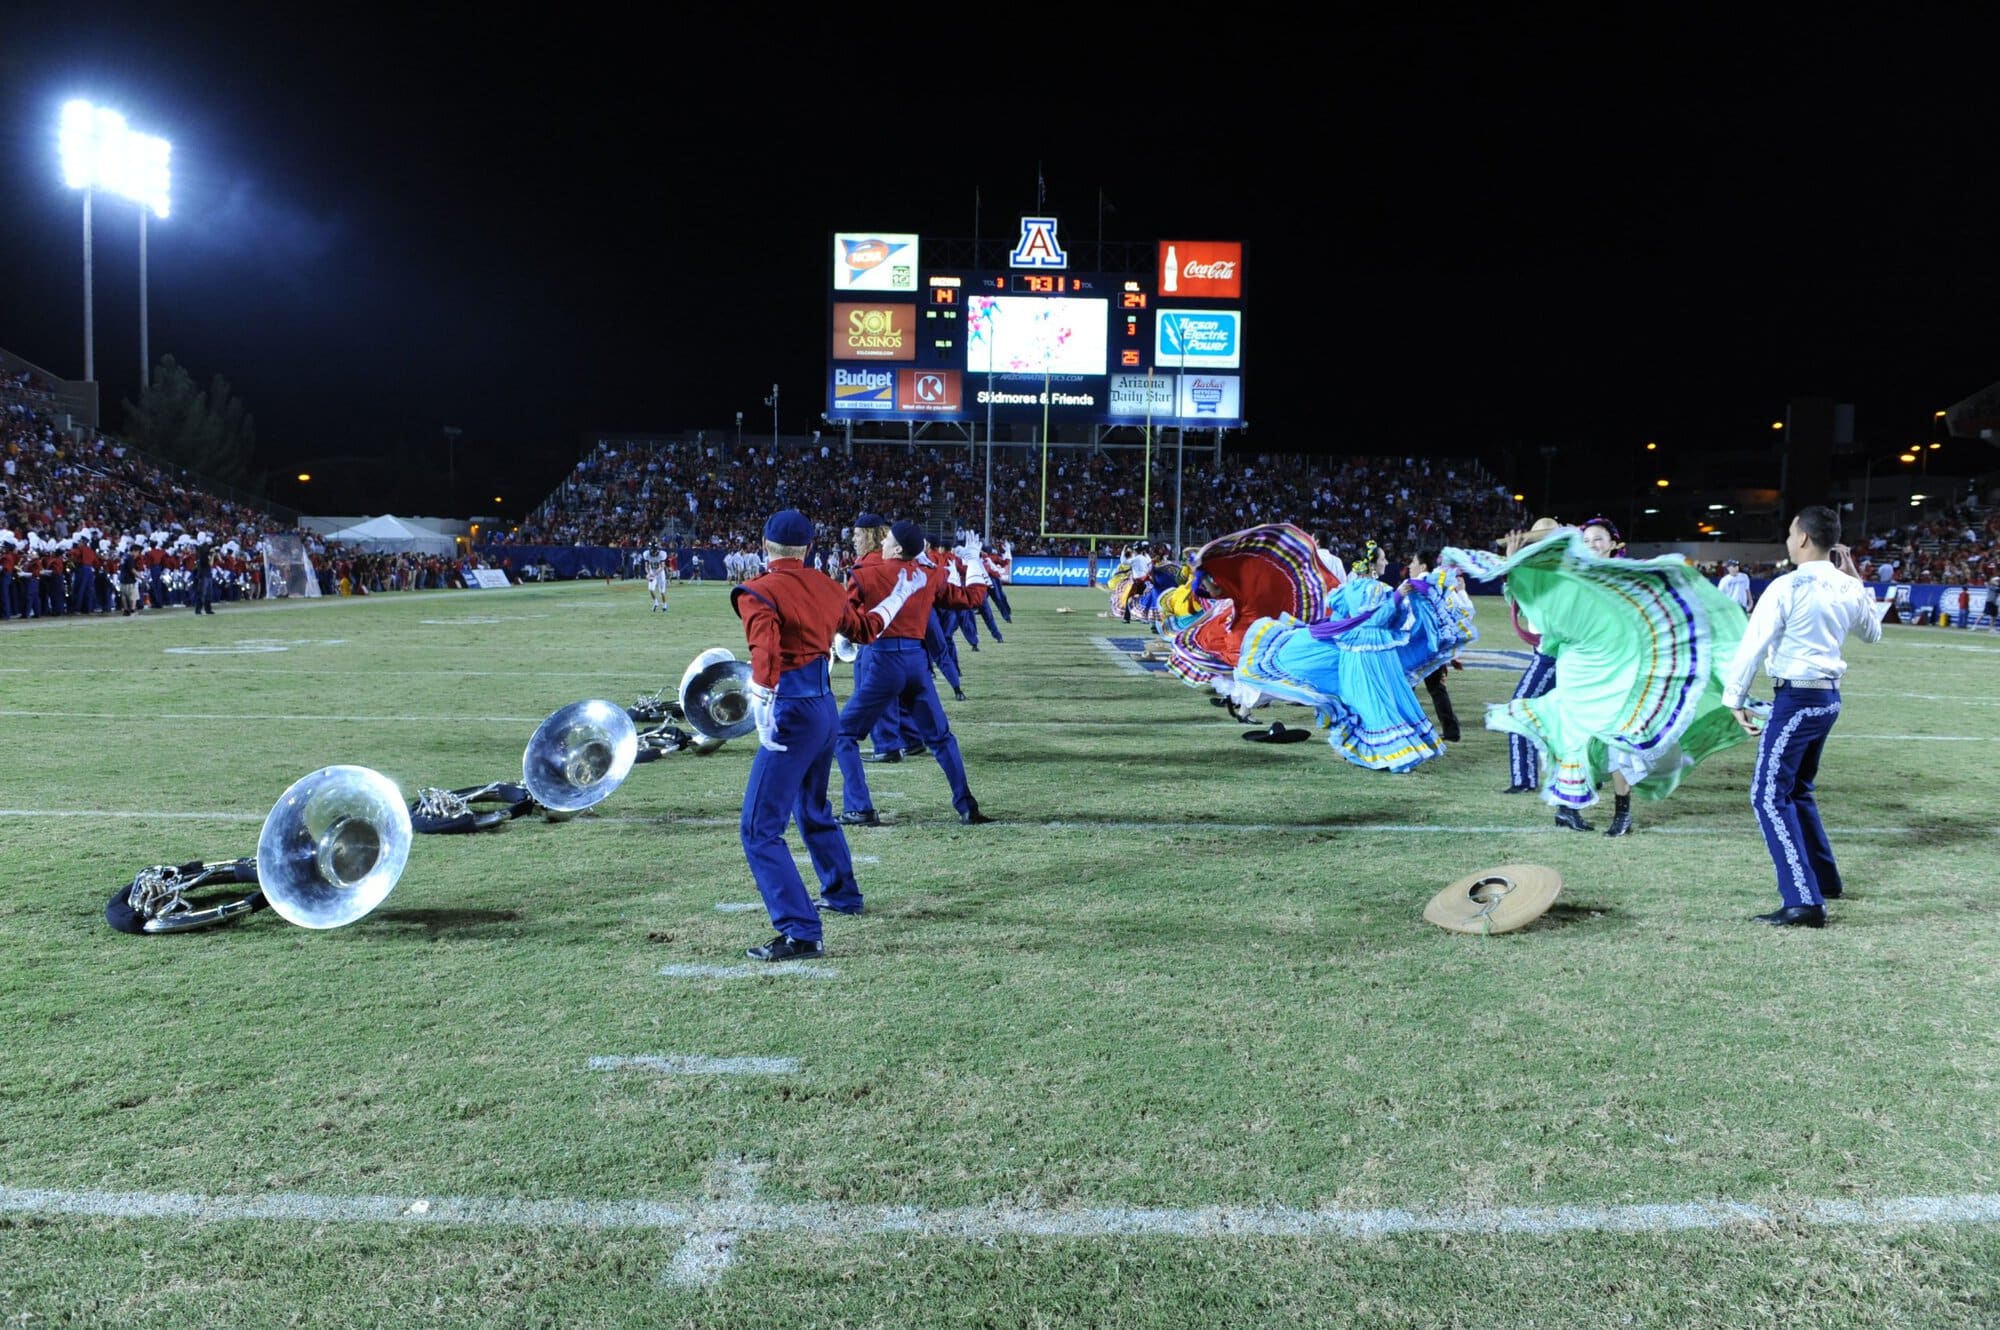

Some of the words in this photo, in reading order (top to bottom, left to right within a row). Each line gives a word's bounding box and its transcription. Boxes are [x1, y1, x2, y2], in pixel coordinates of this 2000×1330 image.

[1010, 217, 1067, 268] A
[1124, 294, 1146, 308] 24
[848, 309, 902, 336] SOL
[1180, 318, 1218, 331] Tucson
[1127, 324, 1136, 336] 3
[1183, 330, 1228, 341] Electric
[848, 336, 902, 348] CASINOS
[1187, 341, 1228, 352] Power
[835, 369, 892, 390] Budget
[1119, 376, 1165, 389] Arizona
[1040, 393, 1049, 405] &
[1052, 393, 1094, 405] Friends
[1111, 389, 1143, 405] Daily
[1146, 391, 1172, 402] Star
